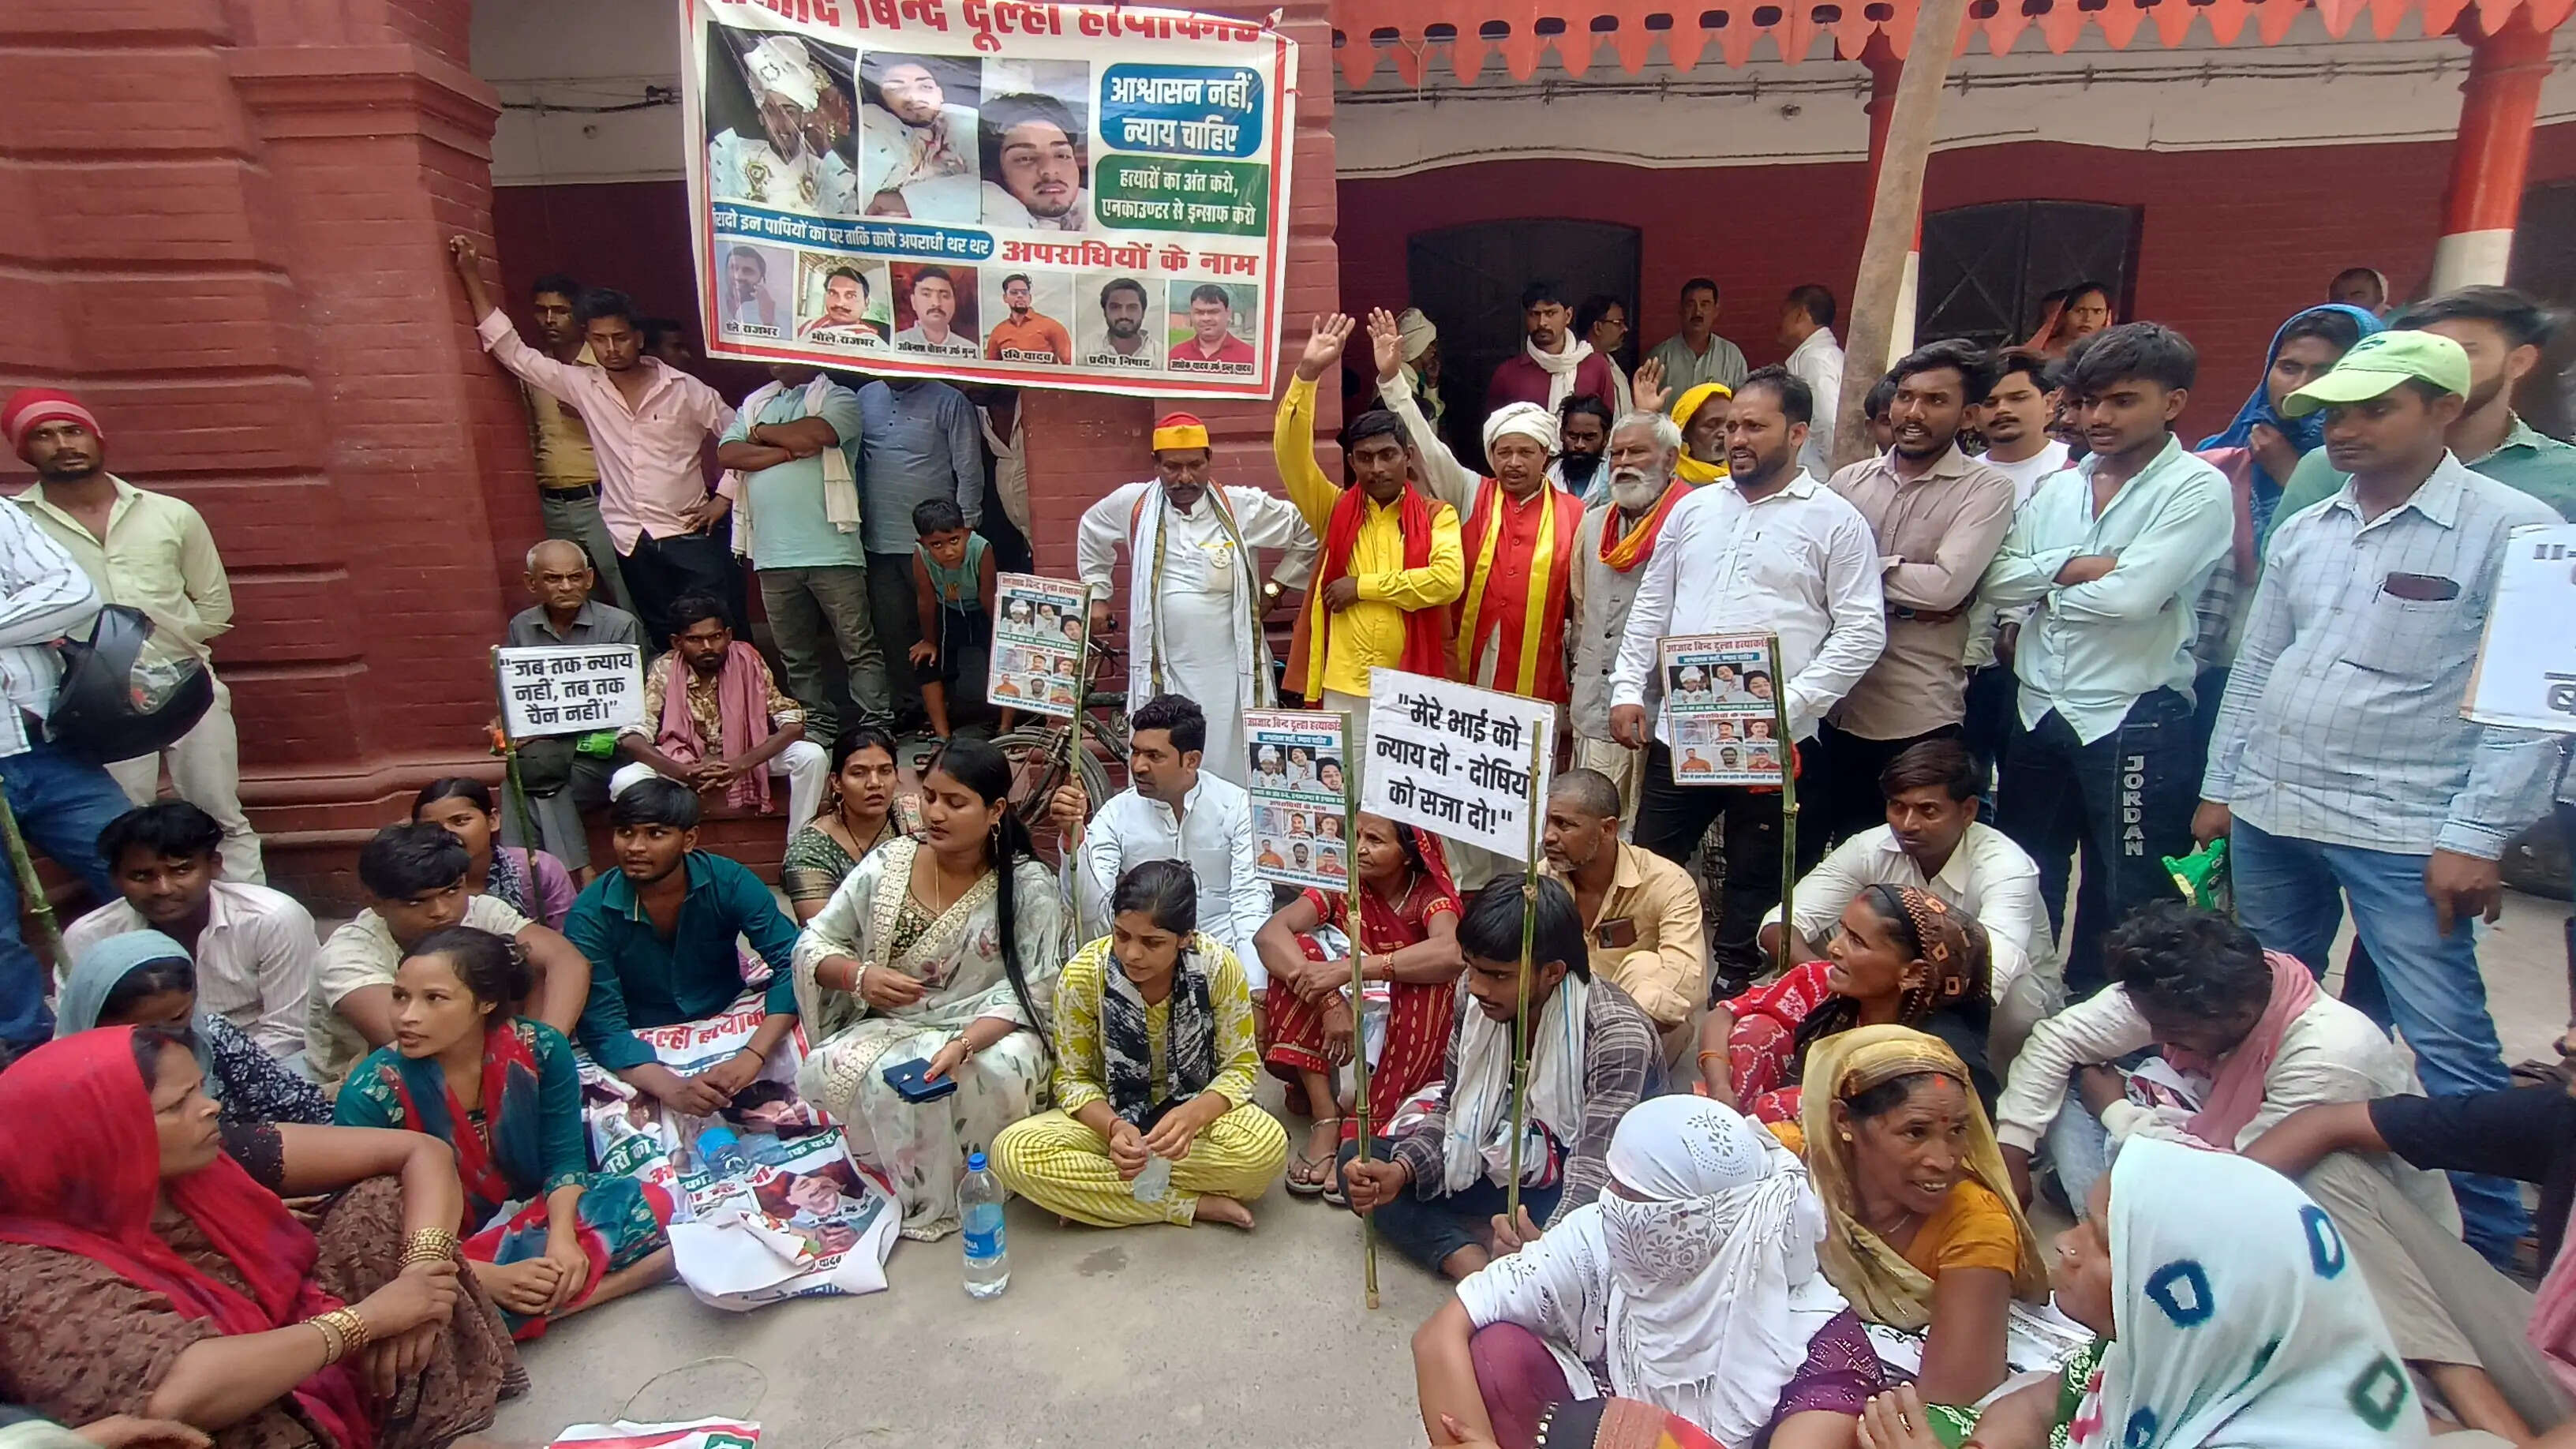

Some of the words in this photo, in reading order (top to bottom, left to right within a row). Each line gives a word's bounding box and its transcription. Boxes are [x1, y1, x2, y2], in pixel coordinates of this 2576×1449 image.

[1110, 77, 1204, 105] आश्वासन
[1206, 72, 1253, 113] नहीं,
[1121, 118, 1178, 147] न्याय
[1180, 114, 1239, 152] चाहिए
[1119, 166, 1162, 189] हत्यारों
[1163, 171, 1181, 191] का
[1184, 169, 1208, 192] अंत
[1210, 170, 1238, 197] करो,
[1172, 197, 1185, 220] से
[1187, 202, 1230, 224] इन्साफ
[1232, 201, 1256, 226] करो
[739, 214, 763, 231] इन
[763, 215, 809, 238] पापियों
[809, 224, 826, 242] का
[844, 225, 871, 246] ताकि
[871, 227, 897, 248] कापे
[899, 231, 945, 251] अपराधी
[947, 237, 968, 253] थर
[969, 239, 990, 254] थर
[1002, 239, 1152, 270] अपराधियों
[1159, 243, 1191, 271] के
[1199, 251, 1260, 276] नाम
[548, 656, 582, 675] तक
[584, 653, 634, 671] न्याय
[512, 678, 559, 702] नहीं,
[561, 680, 591, 699] तब
[593, 676, 626, 696] तक
[525, 703, 560, 725] चैन
[1447, 708, 1489, 744] भाई
[1491, 715, 1522, 751] को
[1375, 733, 1427, 769] न्याय
[1429, 742, 1451, 777] दो
[1469, 752, 1541, 799] दोषियं
[1388, 775, 1417, 809] को
[1419, 787, 1465, 825] सजा
[2122, 755, 2145, 856] JORDAN
[638, 1025, 695, 1050] दल्हा
